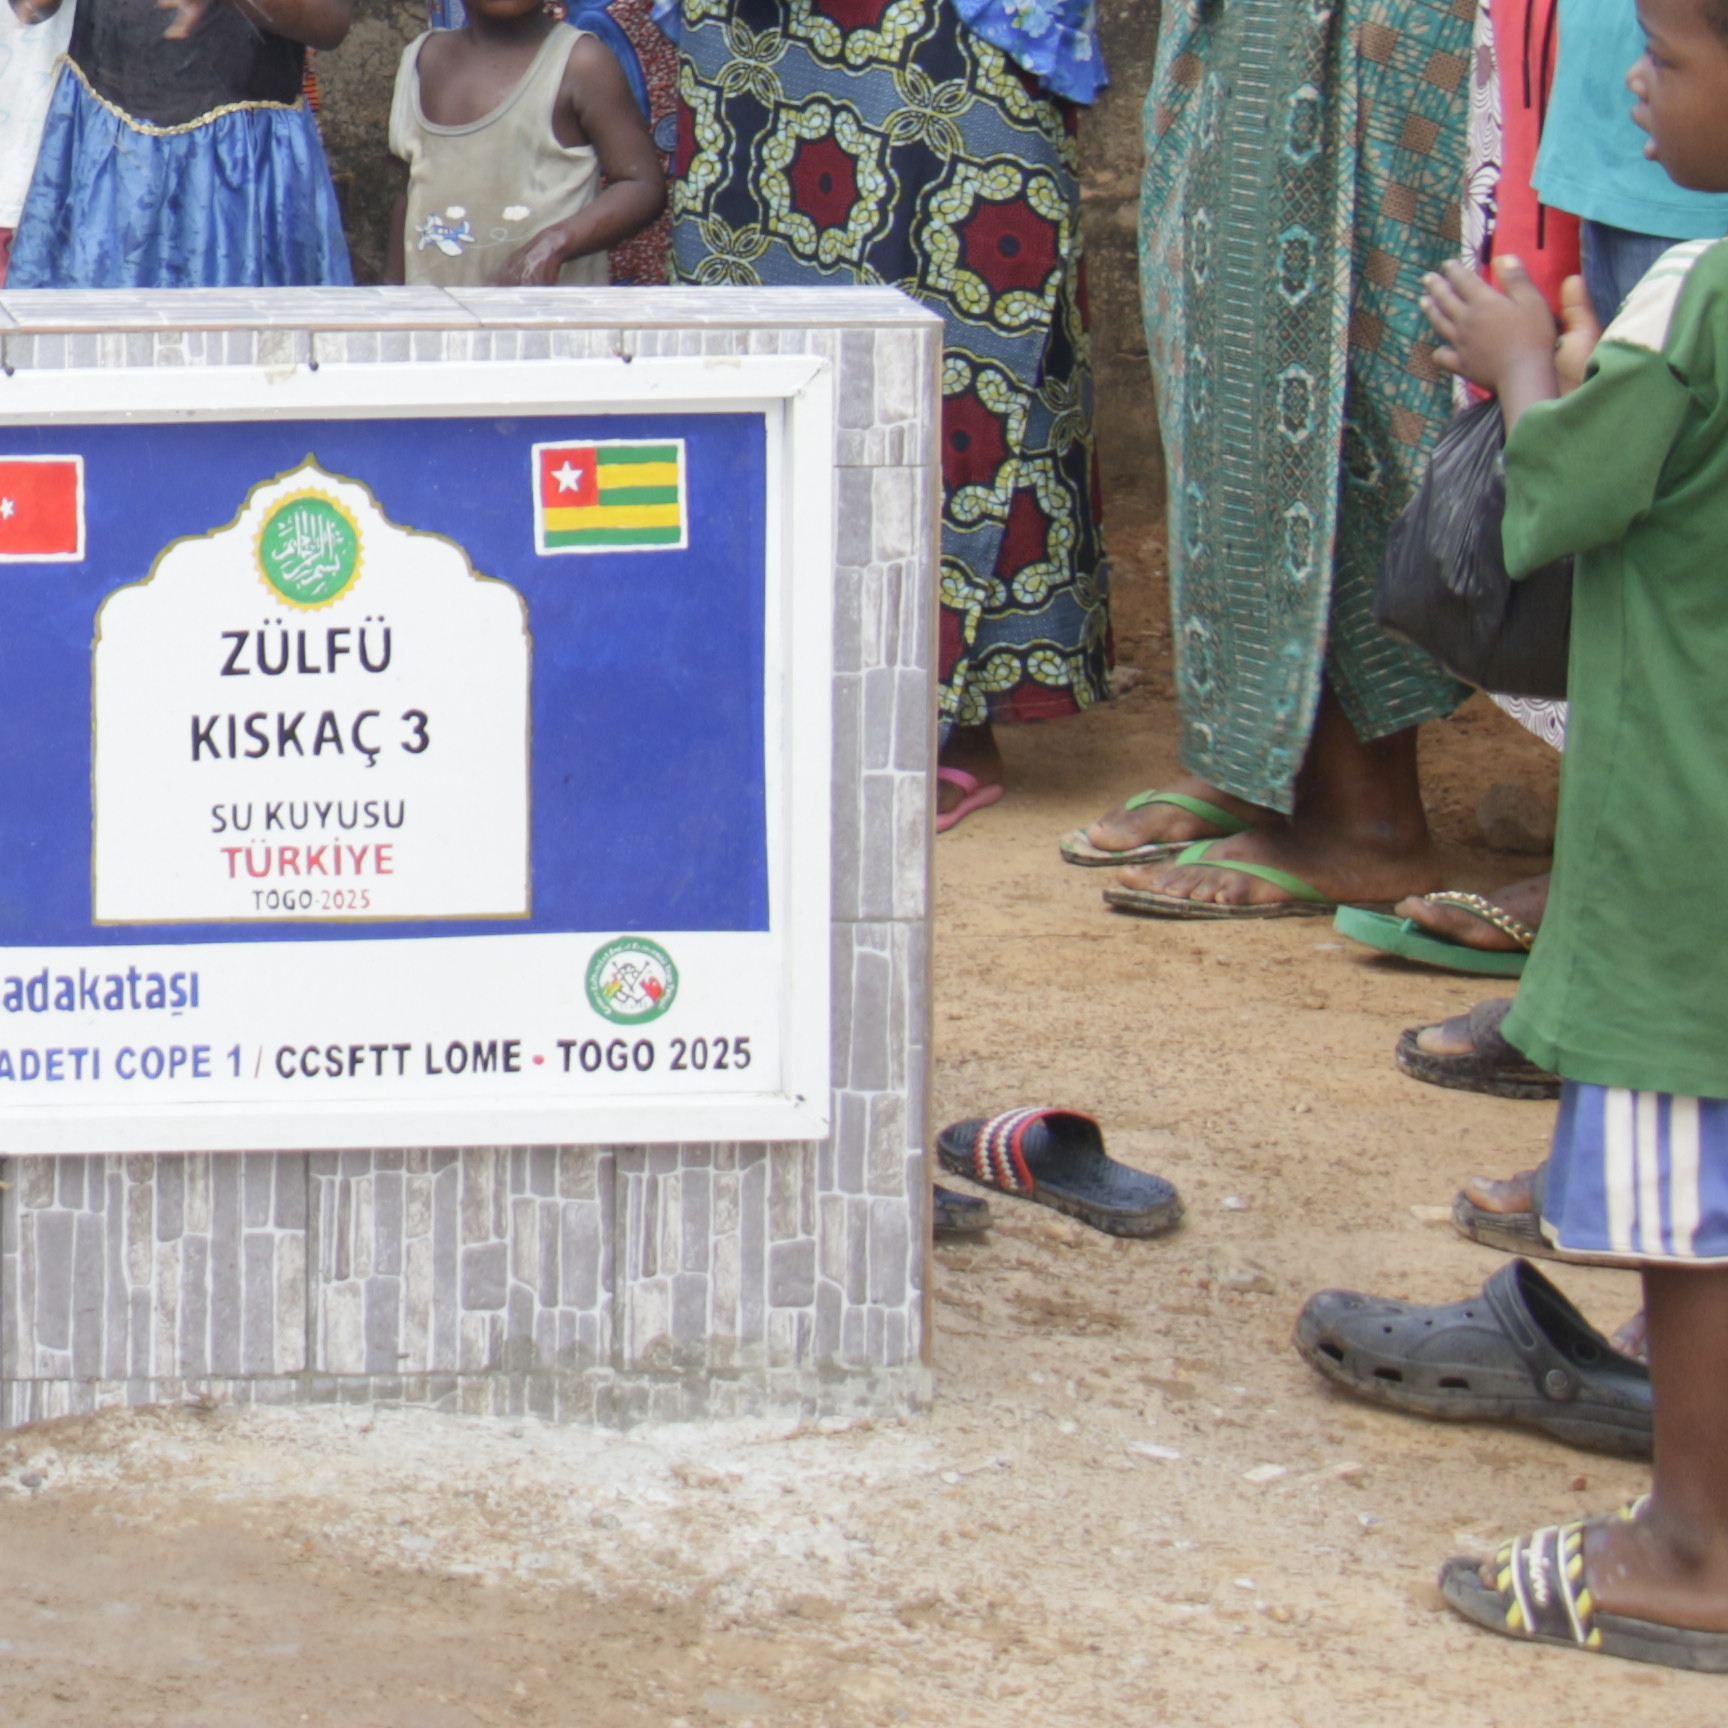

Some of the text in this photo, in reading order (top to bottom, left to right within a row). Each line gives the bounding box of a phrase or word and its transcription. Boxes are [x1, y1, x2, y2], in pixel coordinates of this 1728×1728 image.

[220, 615, 391, 676] ZÜLFÜ
[191, 709, 430, 768] KISKAÇ 3
[211, 799, 405, 833] SU KUYUSU
[220, 837, 394, 879] TÜRKİYE
[114, 1044, 212, 1080] COPE
[226, 1044, 241, 1078] 1
[274, 1042, 413, 1080] CCSFTT
[425, 1039, 522, 1075] LOME
[556, 1038, 655, 1073] TOGO
[670, 1036, 752, 1070] 2025
